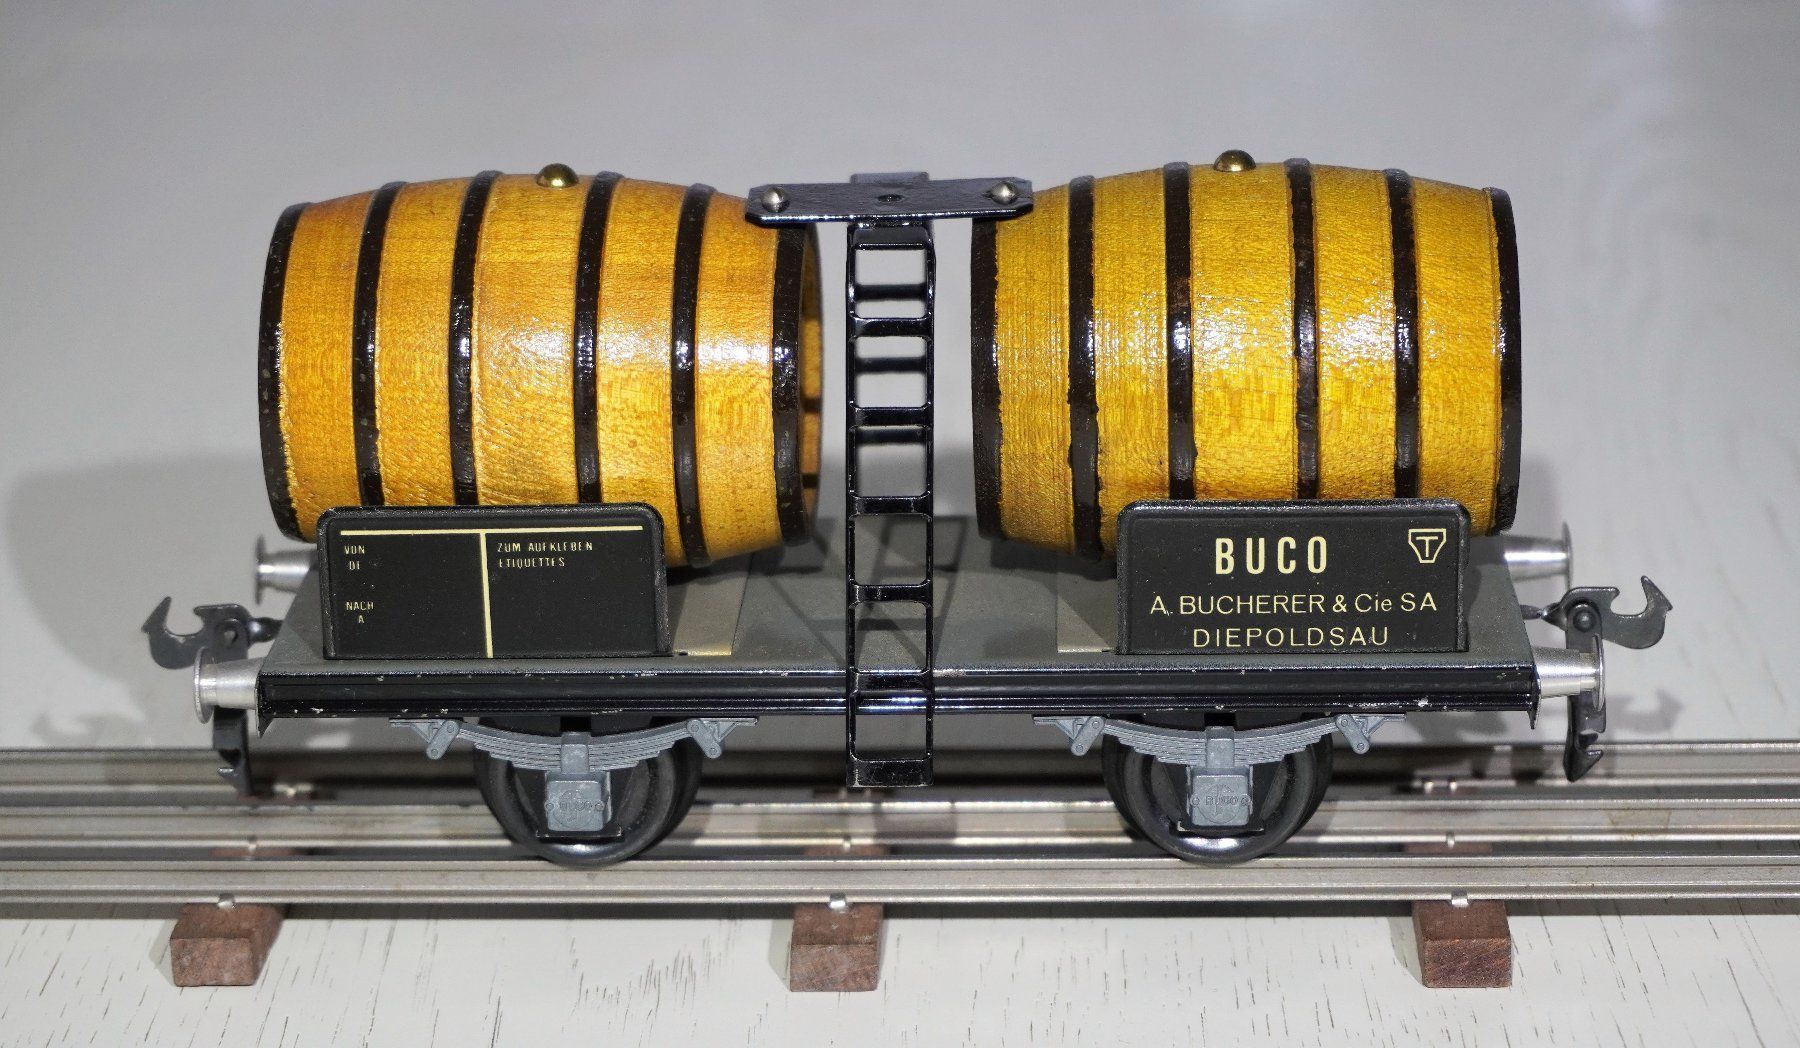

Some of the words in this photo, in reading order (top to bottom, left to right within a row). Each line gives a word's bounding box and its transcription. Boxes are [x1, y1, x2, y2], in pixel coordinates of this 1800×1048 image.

[344, 544, 365, 555] VON
[497, 542, 521, 553] ZUM
[1216, 536, 1327, 575] BUCO
[498, 556, 565, 569] ETIQUETTES
[346, 600, 374, 611] NACH
[1179, 594, 1326, 615] BUCHERER
[1332, 594, 1348, 613] &
[1354, 592, 1393, 613] Cie
[1400, 591, 1438, 612] SA
[1193, 626, 1388, 649] DIEPOLDSAU
